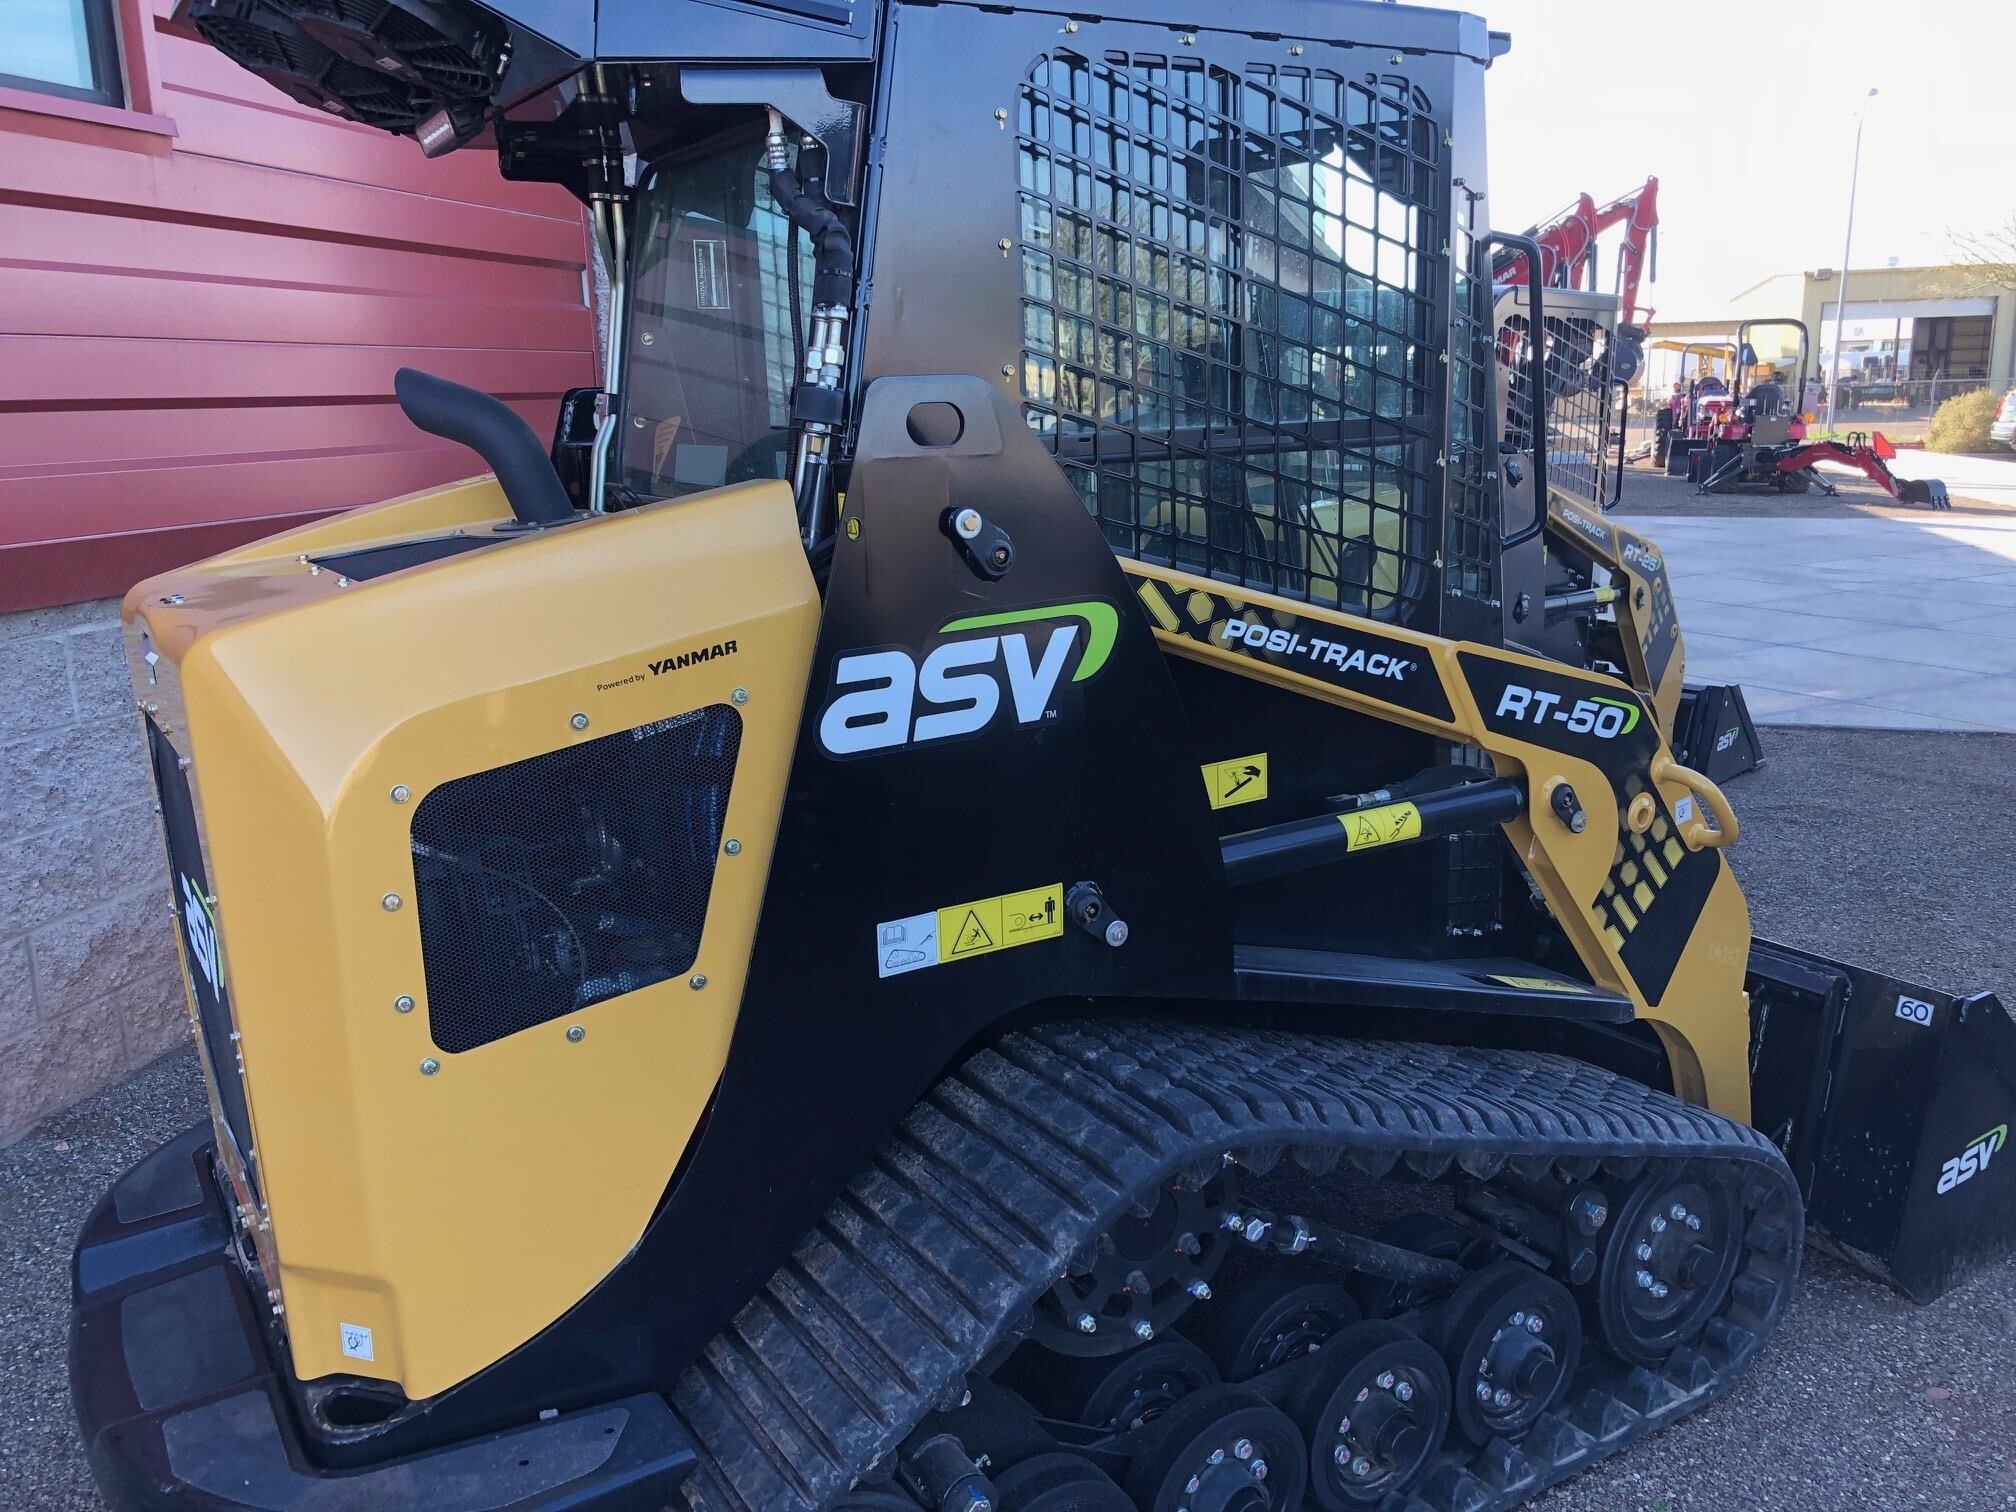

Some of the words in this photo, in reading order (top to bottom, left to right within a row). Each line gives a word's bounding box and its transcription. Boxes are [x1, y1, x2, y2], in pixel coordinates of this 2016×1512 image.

[1624, 543, 1658, 572] RT-25
[597, 676, 634, 692] Powered
[635, 673, 646, 681] by
[648, 639, 738, 676] YANMAR
[1496, 684, 1625, 739] RT-50
[1900, 1000, 1929, 1021] 60
